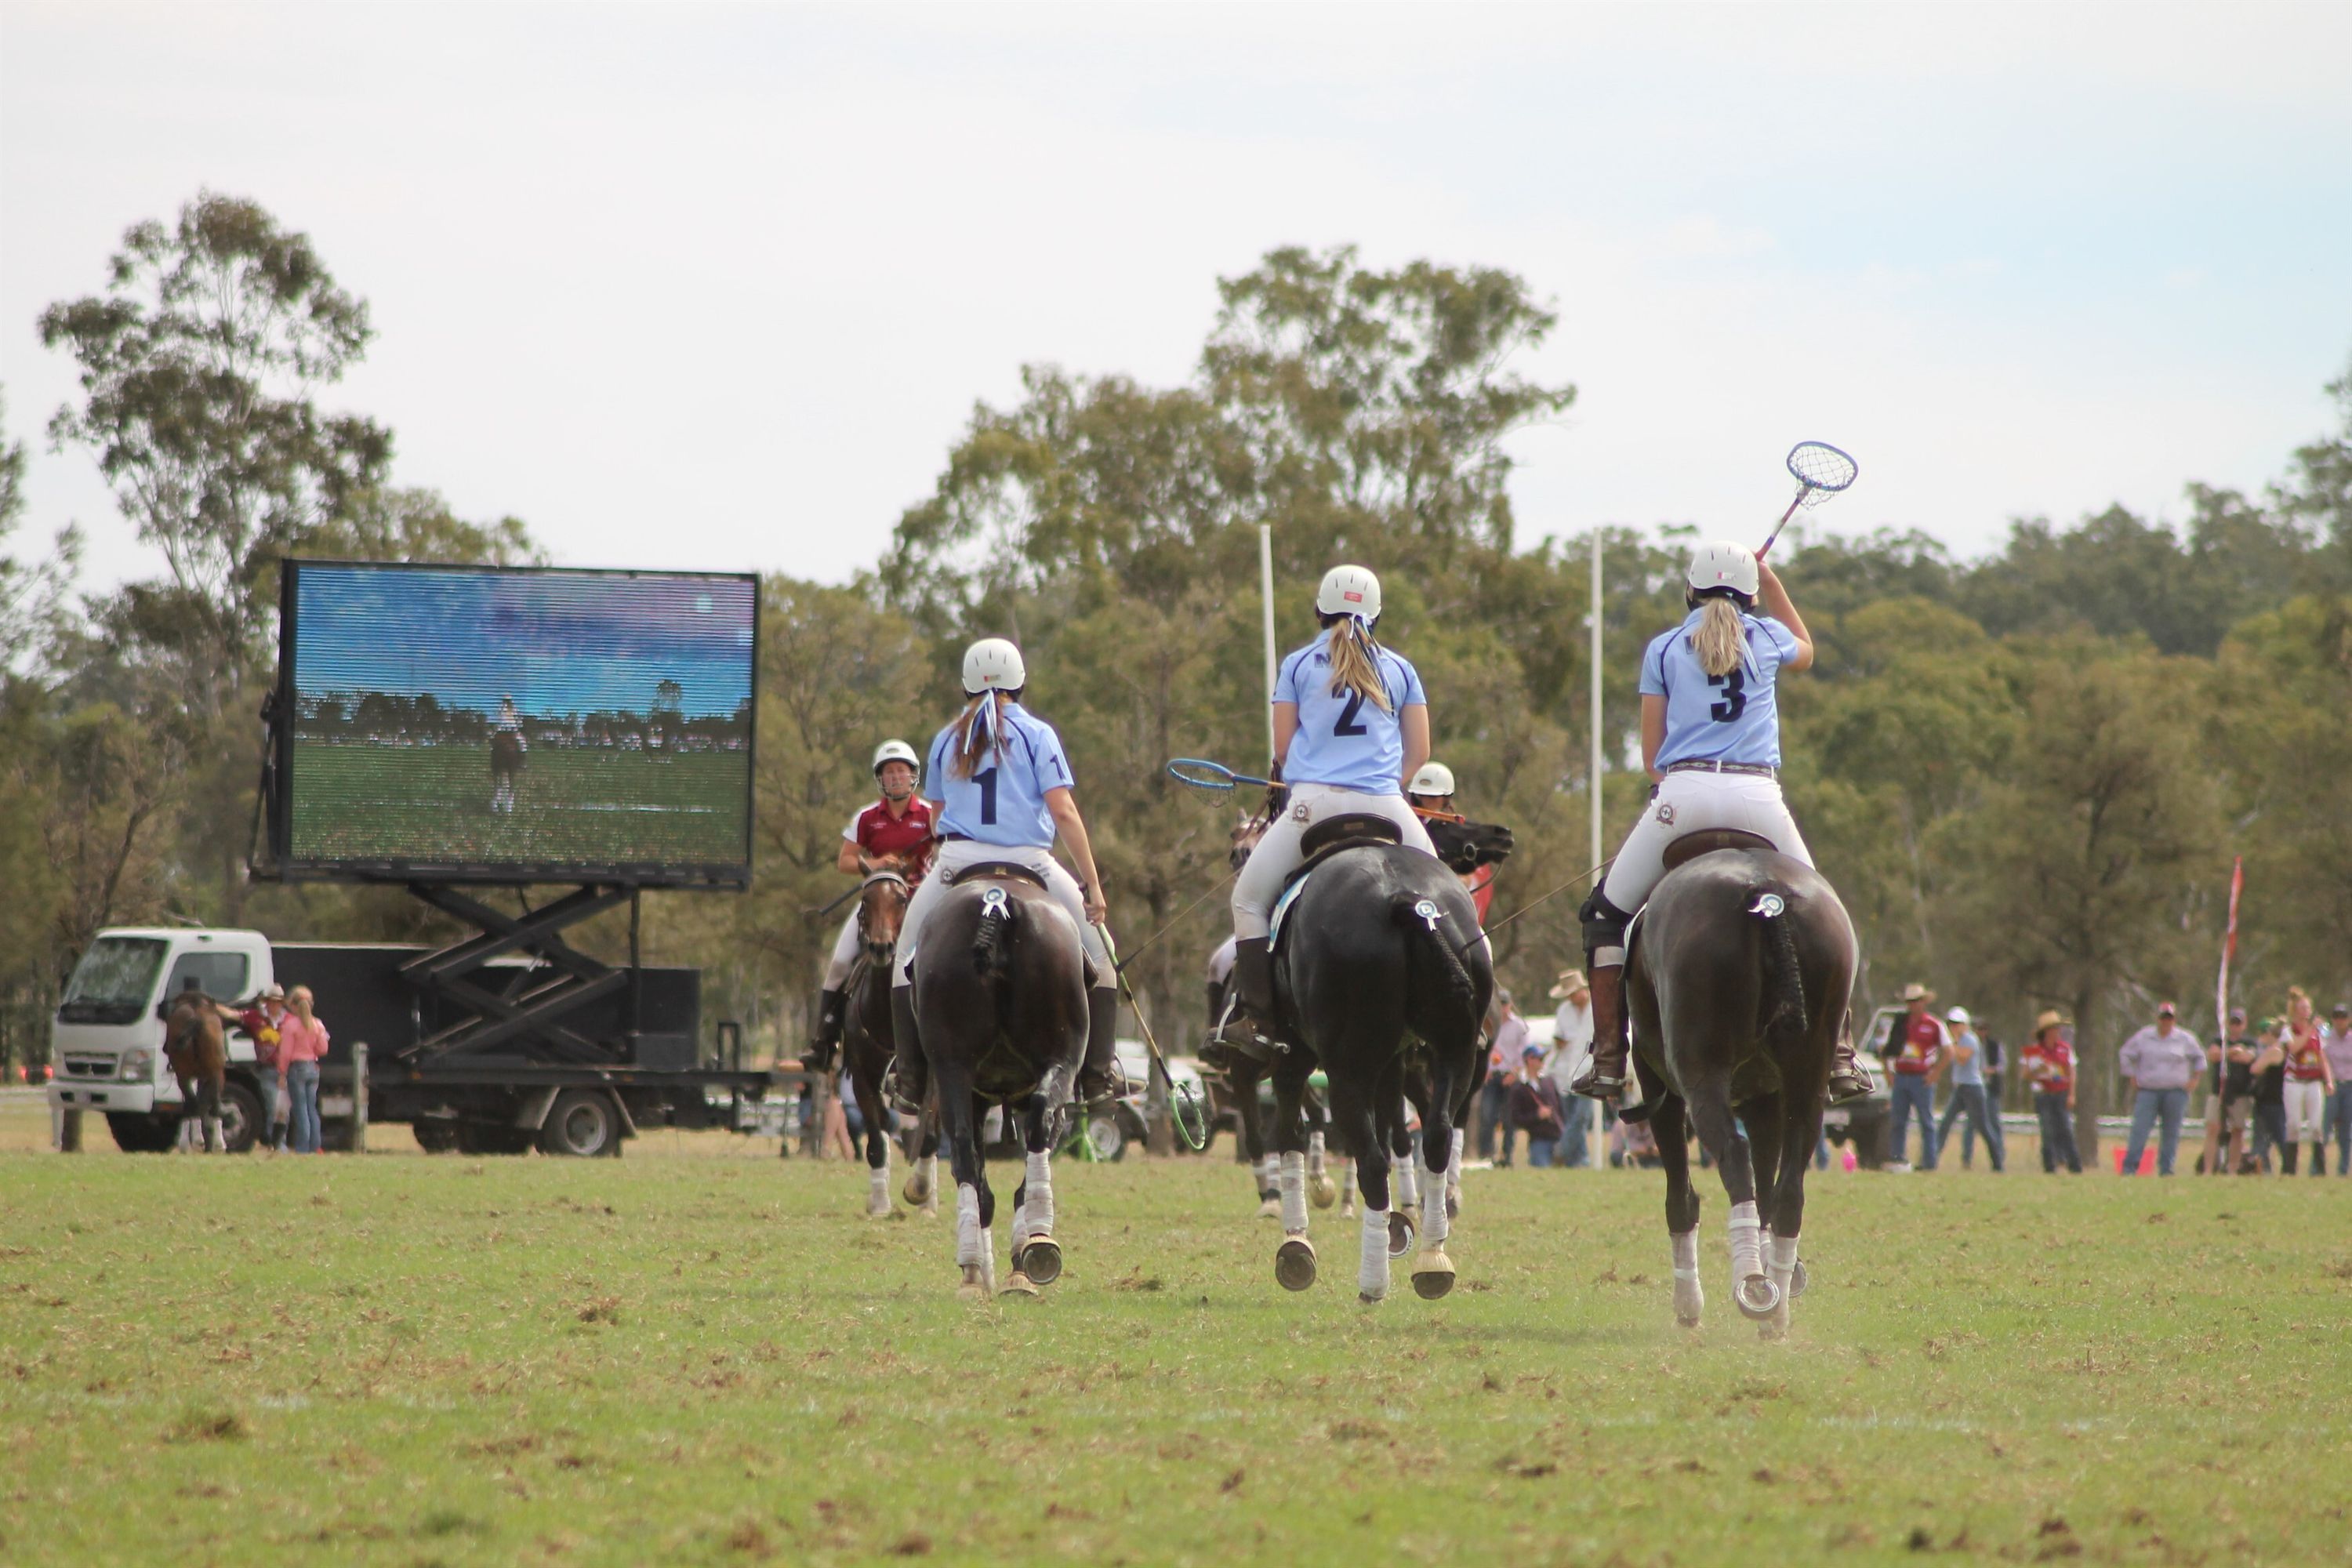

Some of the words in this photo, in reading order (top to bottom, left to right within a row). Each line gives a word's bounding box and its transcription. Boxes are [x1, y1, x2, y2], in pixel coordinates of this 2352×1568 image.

[1331, 680, 1367, 737] 2
[1708, 666, 1748, 723] 3
[1050, 754, 1066, 780] 1
[971, 767, 997, 826] 1
